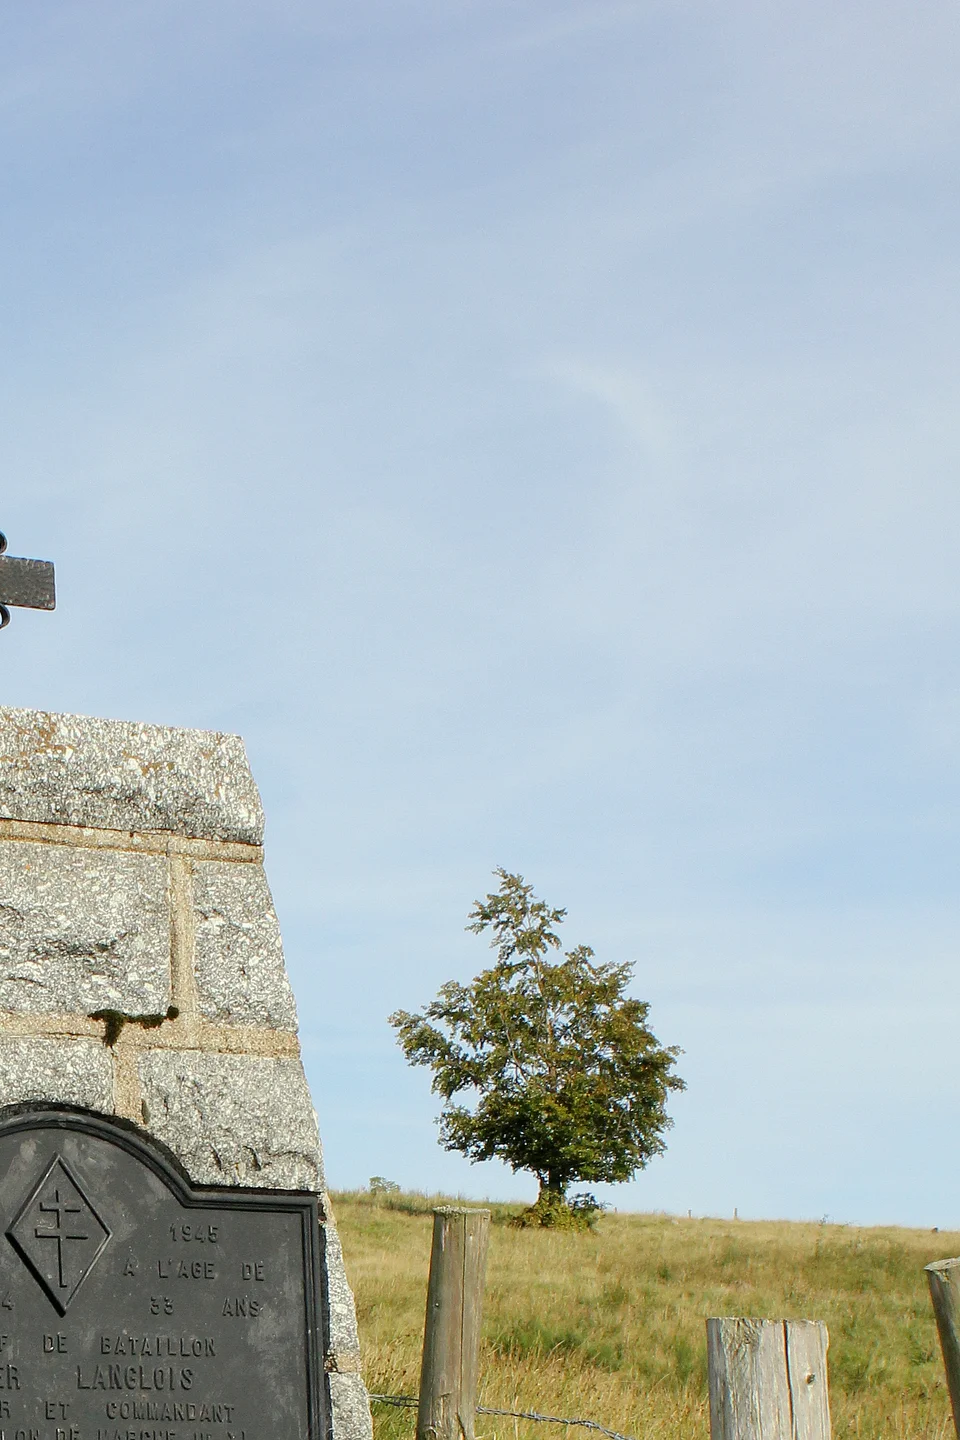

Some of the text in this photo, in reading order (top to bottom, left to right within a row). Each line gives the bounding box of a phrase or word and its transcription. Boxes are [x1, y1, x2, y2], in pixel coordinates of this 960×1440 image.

[169, 1223, 220, 1244] 1945
[123, 1258, 265, 1282] A L'AGE DE
[149, 1296, 260, 1318] 33 ANS
[42, 1333, 68, 1354] DE
[100, 1335, 217, 1358] BATAILLON
[76, 1364, 194, 1391] LANGLOIS
[45, 1400, 70, 1421] ET
[106, 1401, 235, 1424] COMMANDANT
